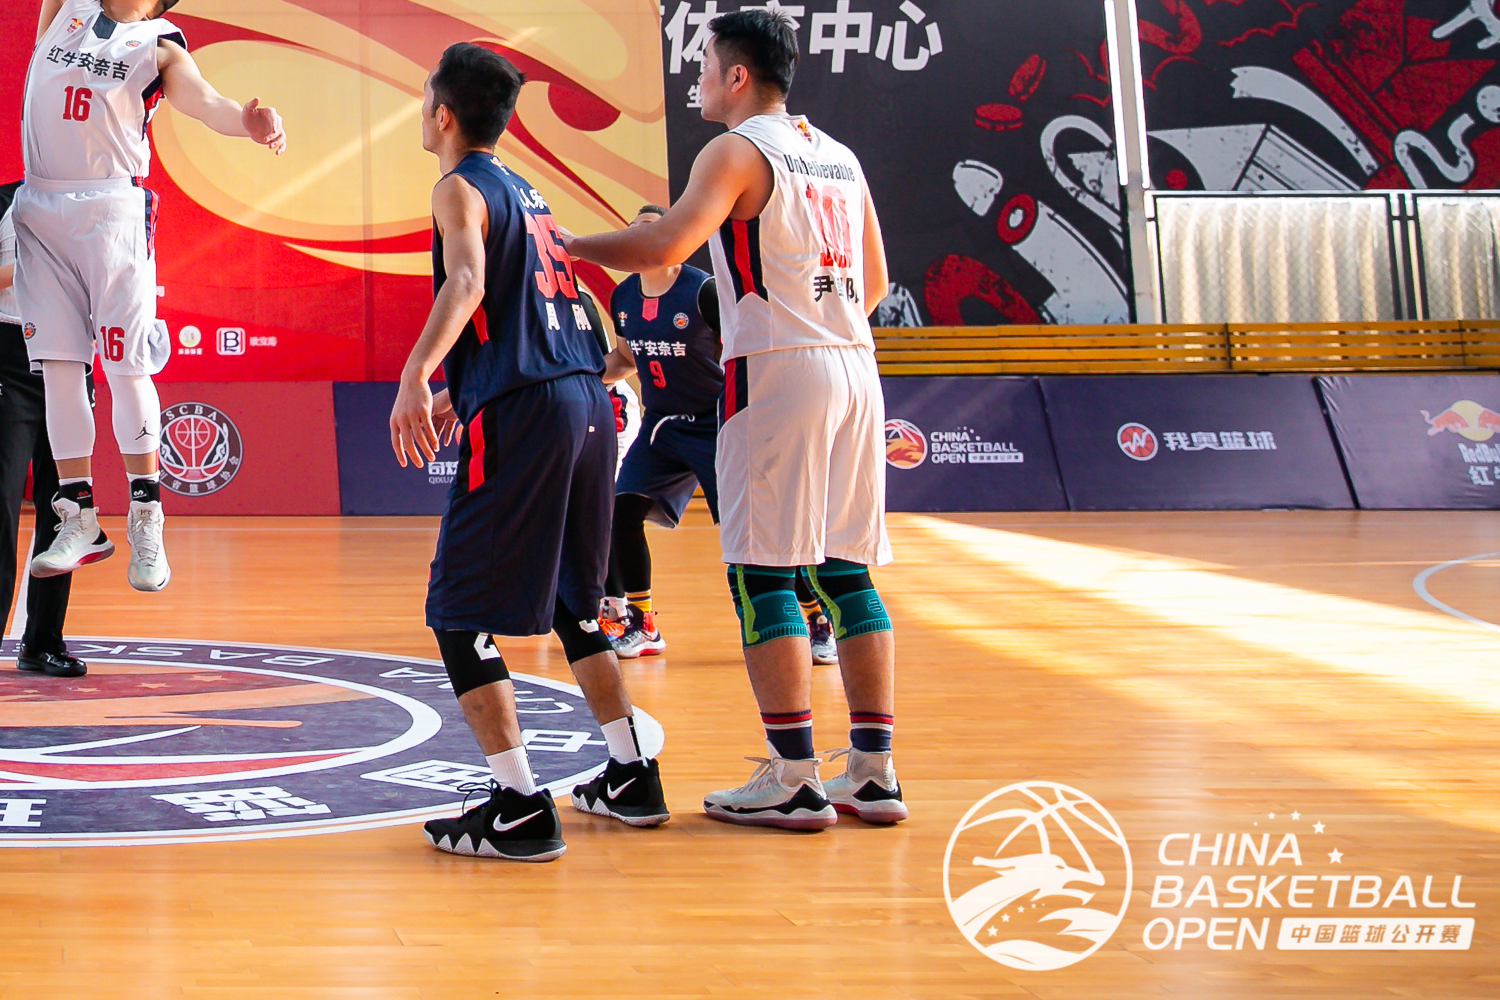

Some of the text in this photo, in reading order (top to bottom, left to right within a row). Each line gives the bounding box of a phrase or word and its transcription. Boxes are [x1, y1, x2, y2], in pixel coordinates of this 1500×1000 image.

[62, 85, 93, 122] 16
[783, 153, 856, 182] Unbelievable
[99, 325, 126, 362] 16
[649, 360, 667, 389] 9
[165, 405, 218, 421] SCBA
[930, 431, 971, 442] CHINA
[931, 442, 1019, 453] BASKETBALL
[931, 453, 967, 463] OPEN
